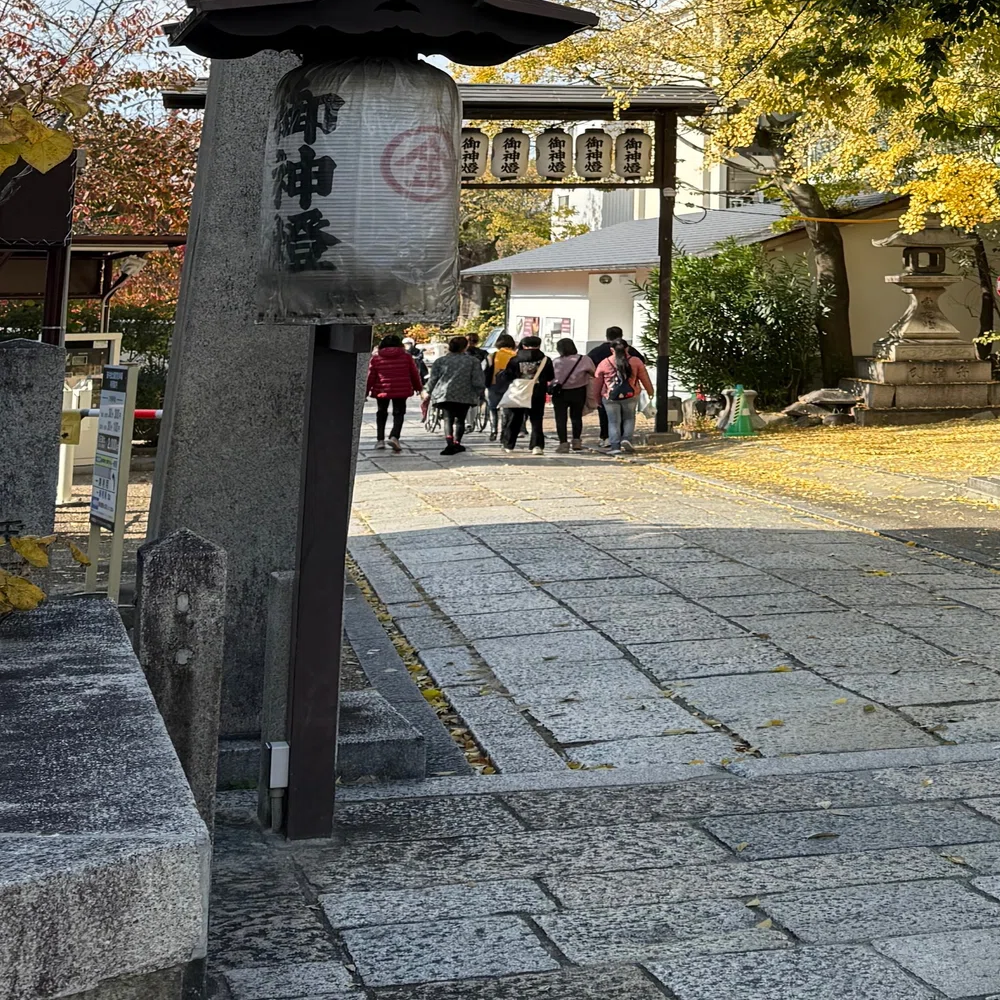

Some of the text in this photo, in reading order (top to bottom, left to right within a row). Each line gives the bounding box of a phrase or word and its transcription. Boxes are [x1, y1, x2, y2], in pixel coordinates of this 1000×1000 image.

[501, 137, 522, 174] 御神燈
[548, 136, 566, 174] 御神燈
[584, 136, 603, 174] 御神燈
[623, 137, 642, 174] 御神燈
